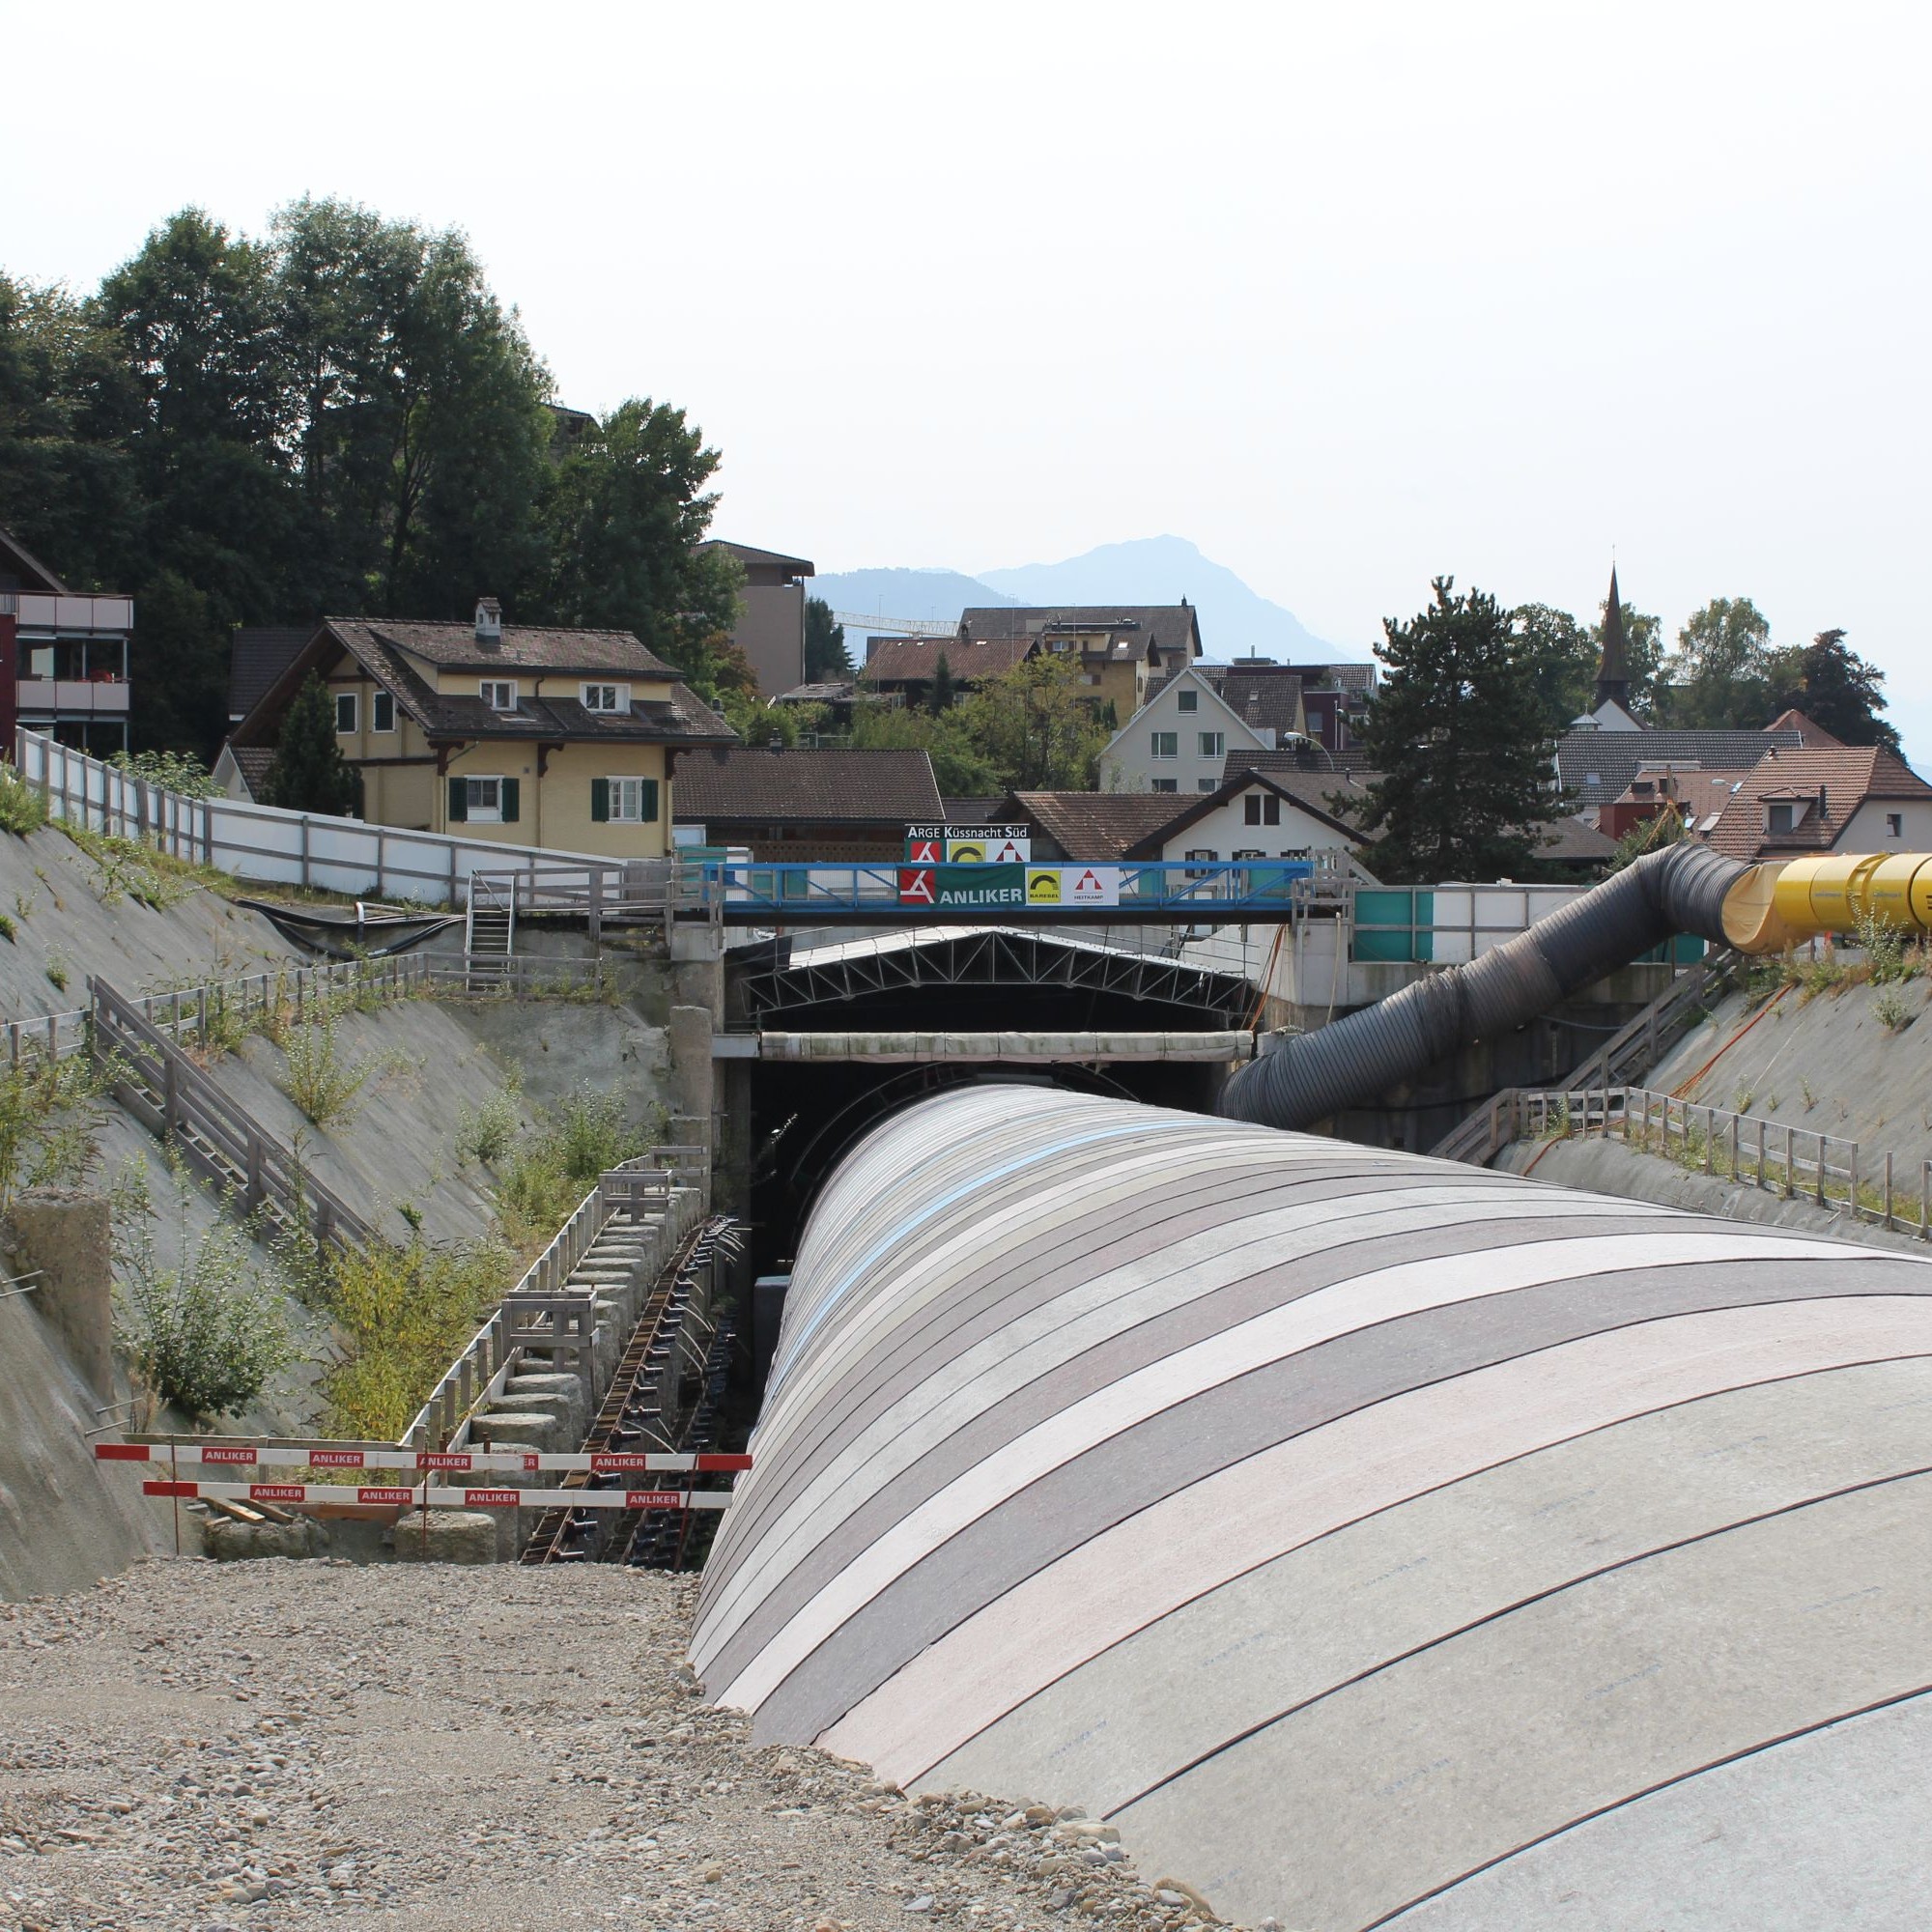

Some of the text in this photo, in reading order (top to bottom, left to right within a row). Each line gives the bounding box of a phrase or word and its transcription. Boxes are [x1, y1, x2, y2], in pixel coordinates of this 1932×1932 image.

[908, 826, 1027, 838] ARGE Küssnacht Süd
[940, 888, 1023, 904] ANLIKER
[205, 1451, 254, 1462] ANLIKER
[312, 1455, 361, 1463] ANLIKER
[595, 1458, 643, 1467] ANLIKER
[254, 1489, 302, 1498] ANLIKER
[361, 1491, 410, 1500] ANLIKER
[469, 1493, 517, 1502] ANLIKER
[630, 1494, 677, 1504] ANLIKER
